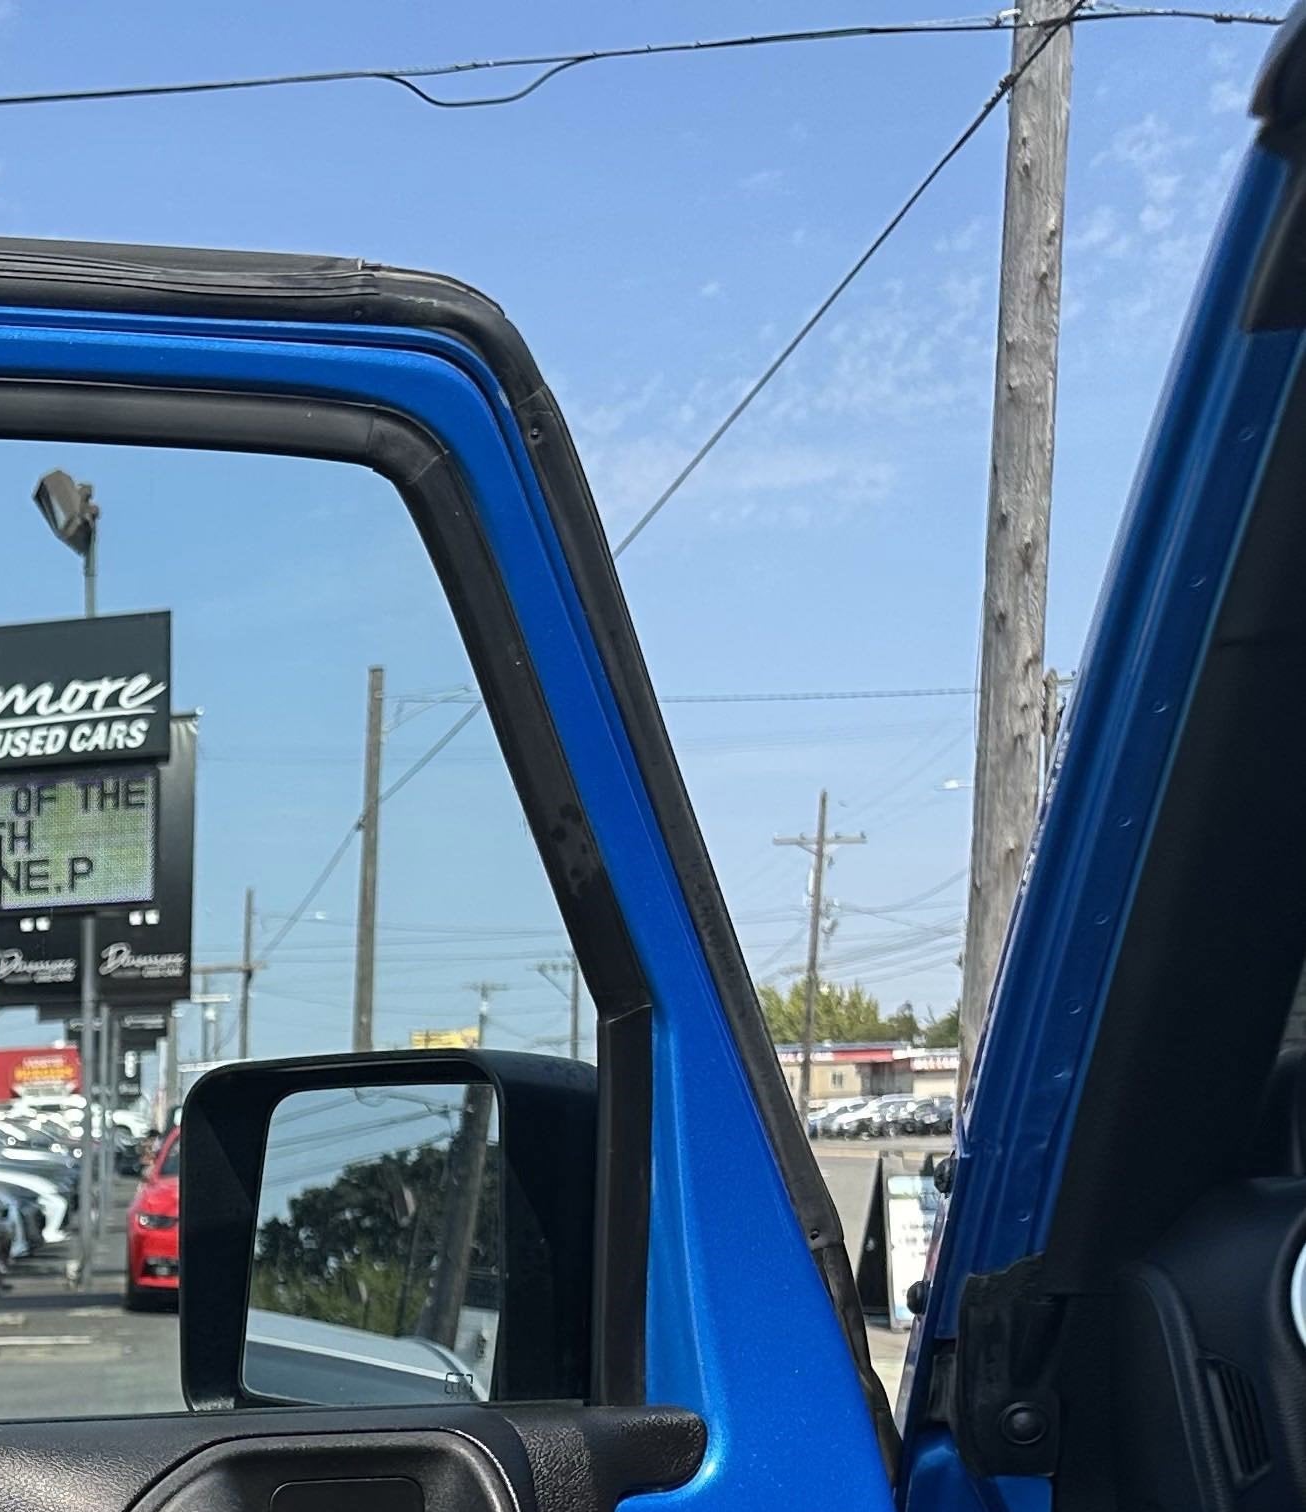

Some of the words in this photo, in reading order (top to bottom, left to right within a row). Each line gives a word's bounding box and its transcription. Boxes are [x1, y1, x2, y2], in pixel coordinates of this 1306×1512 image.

[69, 718, 150, 753] CARS
[13, 783, 56, 816] OF
[80, 777, 146, 813] THE
